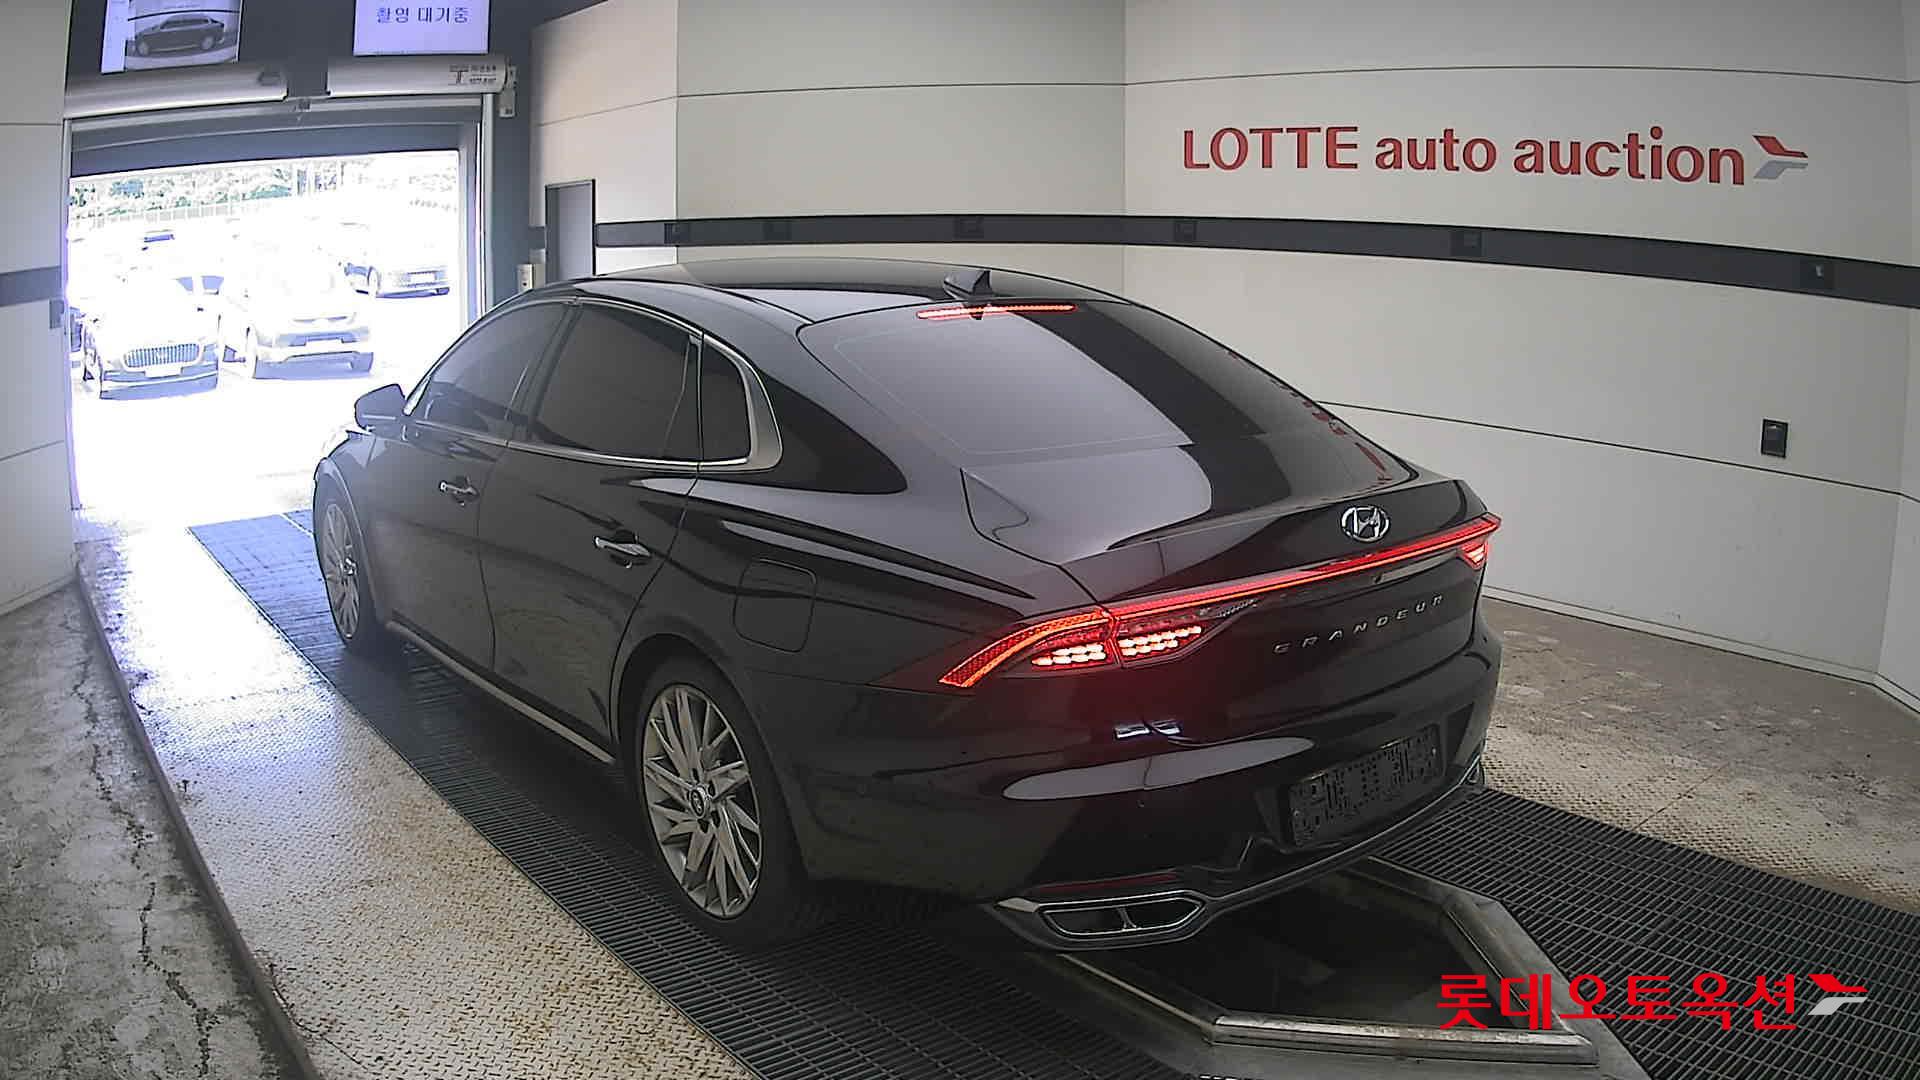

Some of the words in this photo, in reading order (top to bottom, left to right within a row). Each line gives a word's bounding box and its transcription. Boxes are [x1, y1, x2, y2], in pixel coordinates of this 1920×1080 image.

[417, 7, 468, 24] 대기중
[1183, 126, 1359, 171] LOTTE
[1375, 128, 1498, 172] auto
[1513, 126, 1745, 186] auction
[1272, 594, 1443, 655] GRANDEUR
